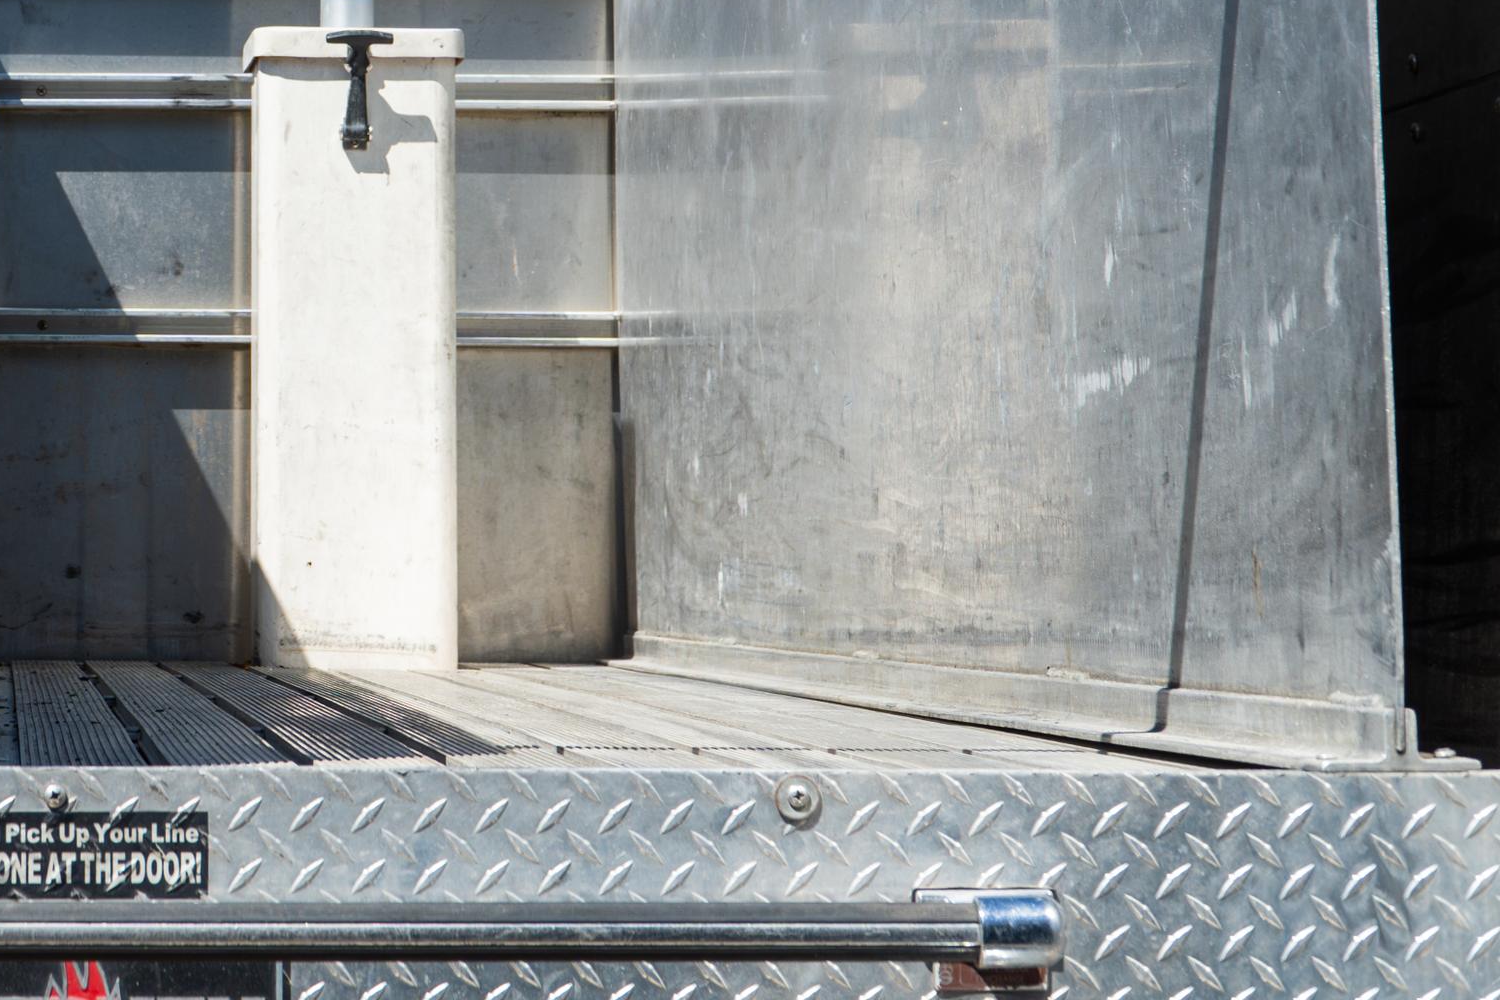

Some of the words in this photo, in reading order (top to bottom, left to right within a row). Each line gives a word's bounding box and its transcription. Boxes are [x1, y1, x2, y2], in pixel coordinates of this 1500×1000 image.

[5, 822, 55, 844] Pick
[58, 822, 90, 847] Up
[93, 822, 148, 844] Your
[151, 822, 200, 844] Line
[45, 852, 77, 885] AT
[80, 852, 126, 885] THE
[130, 852, 202, 885] DOOR!
